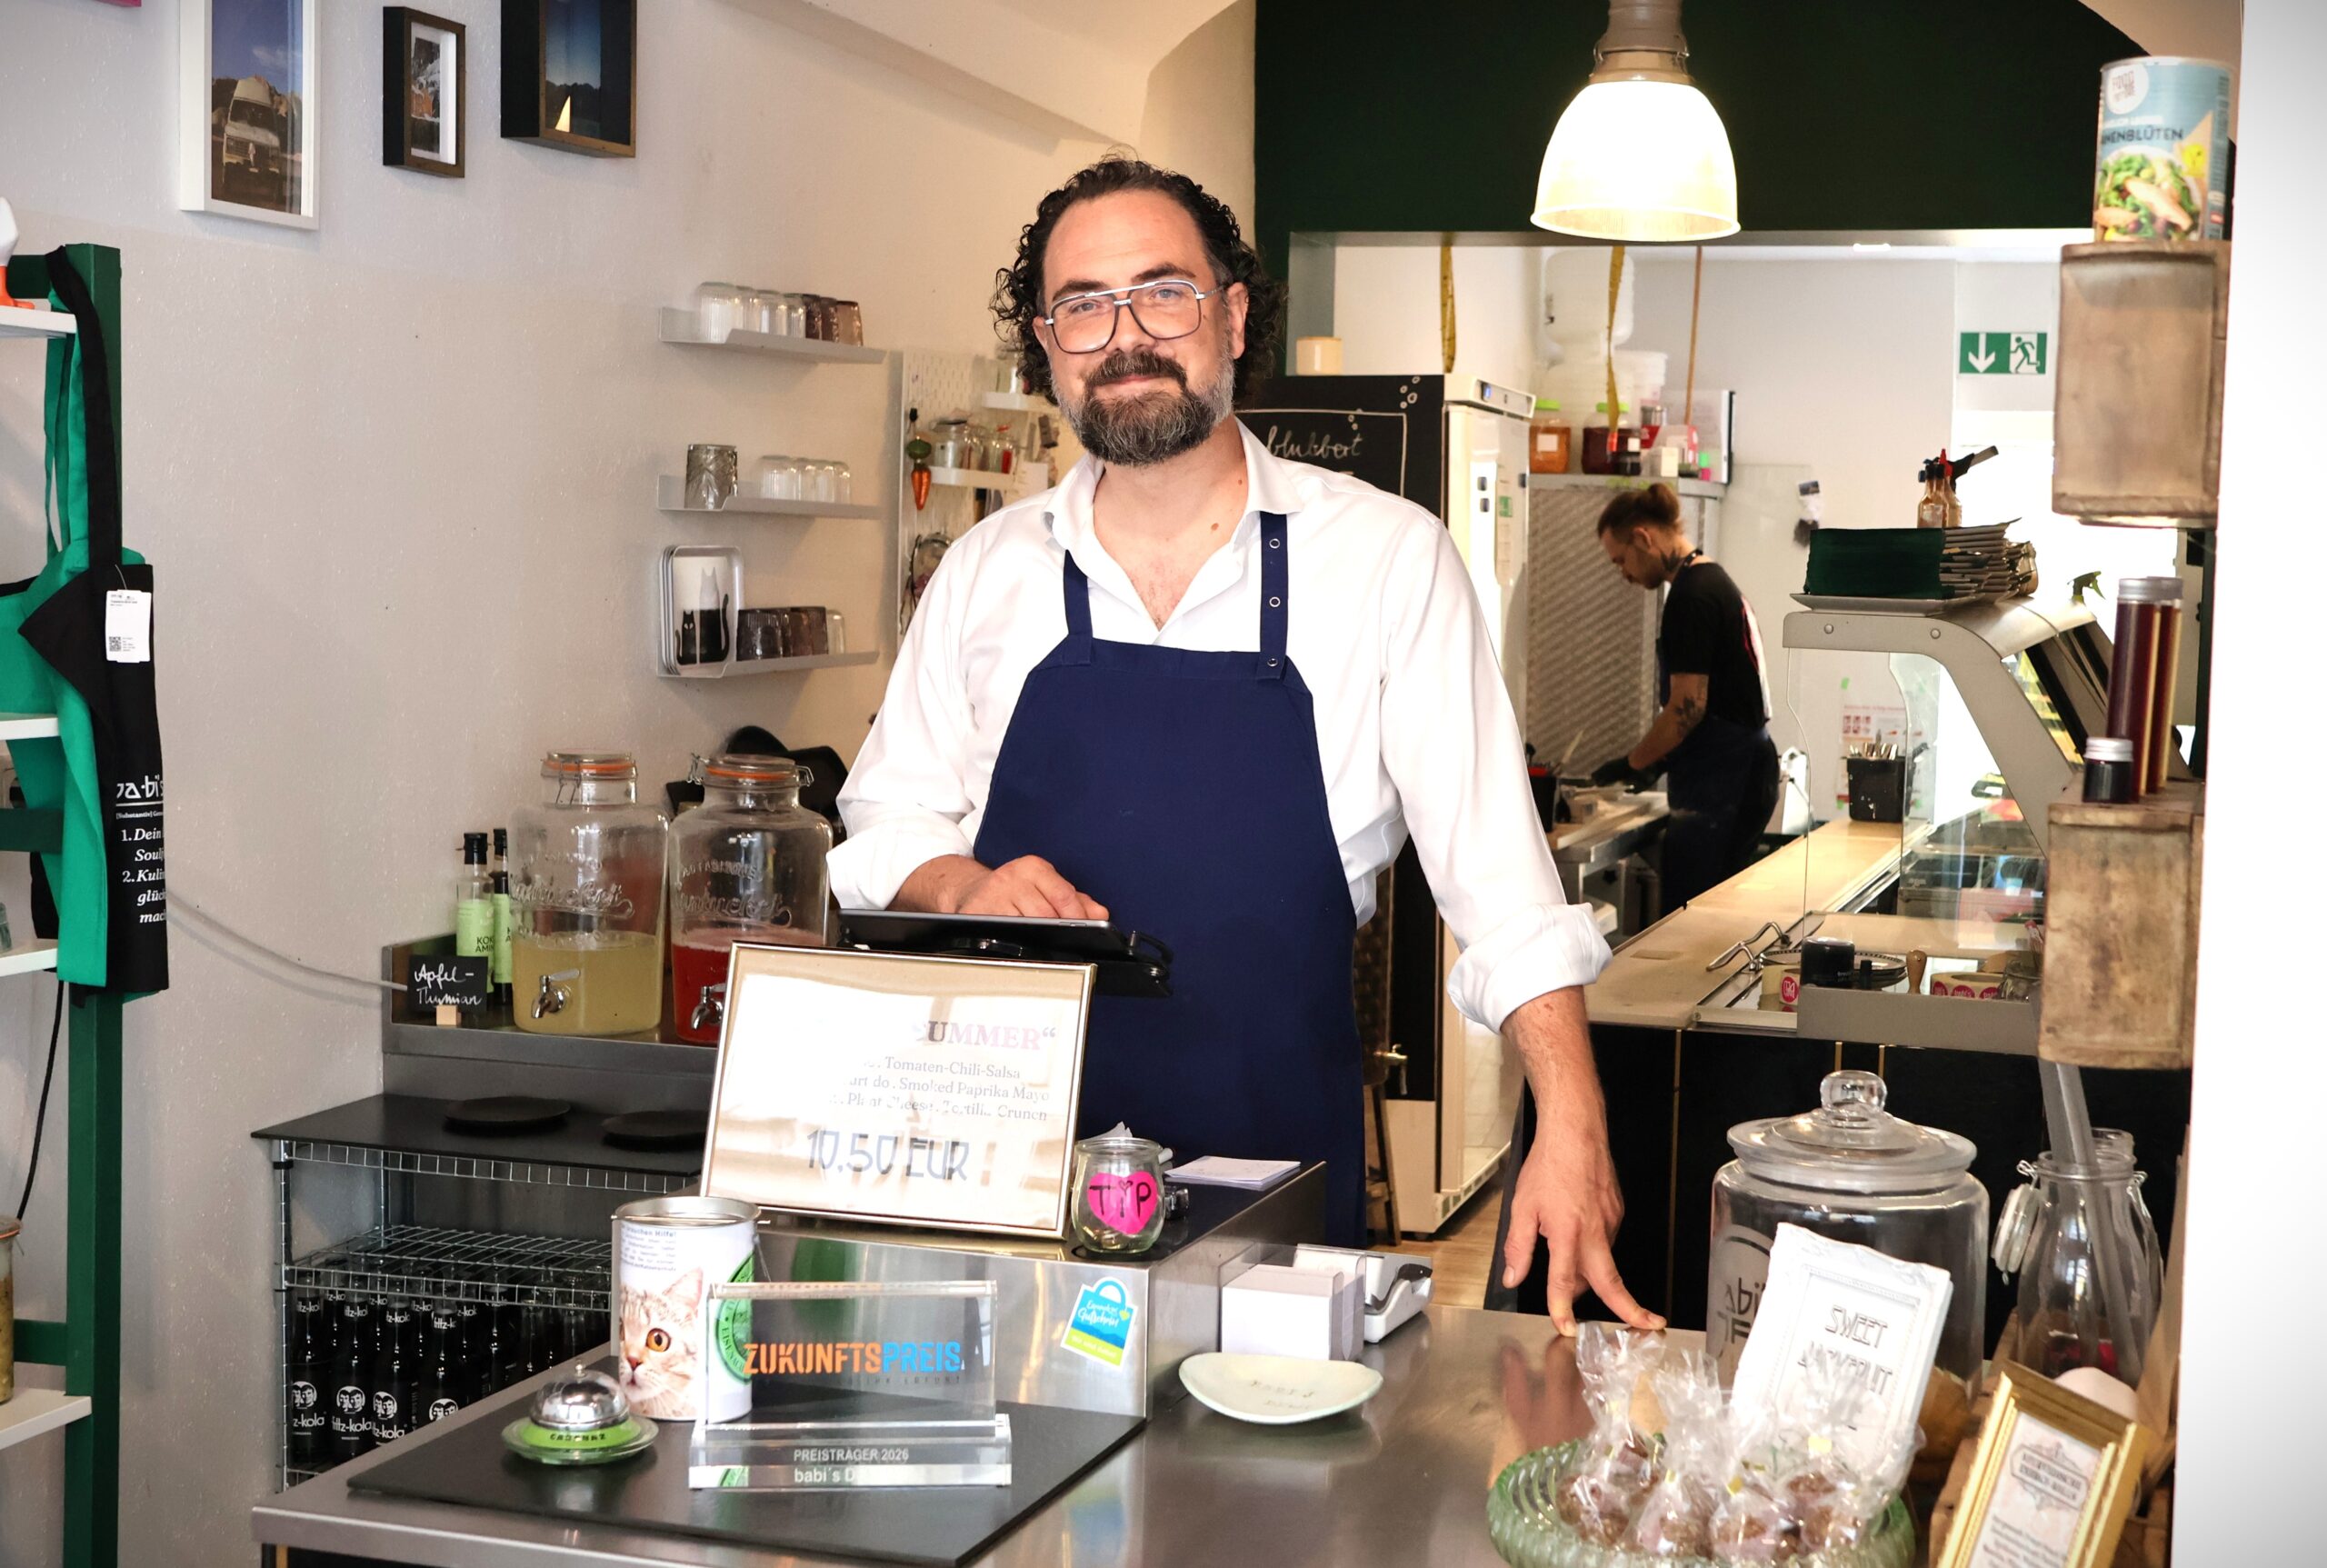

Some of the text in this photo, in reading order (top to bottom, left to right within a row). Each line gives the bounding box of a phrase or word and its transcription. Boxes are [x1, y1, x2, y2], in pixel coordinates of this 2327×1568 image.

[884, 1056, 1021, 1079] Tomaten-Chili-Salsa
[956, 1082, 1009, 1099] Paprika
[1013, 1087, 1050, 1104] Mayo
[905, 1137, 971, 1181] EUR
[881, 1448, 910, 1462] 2026
